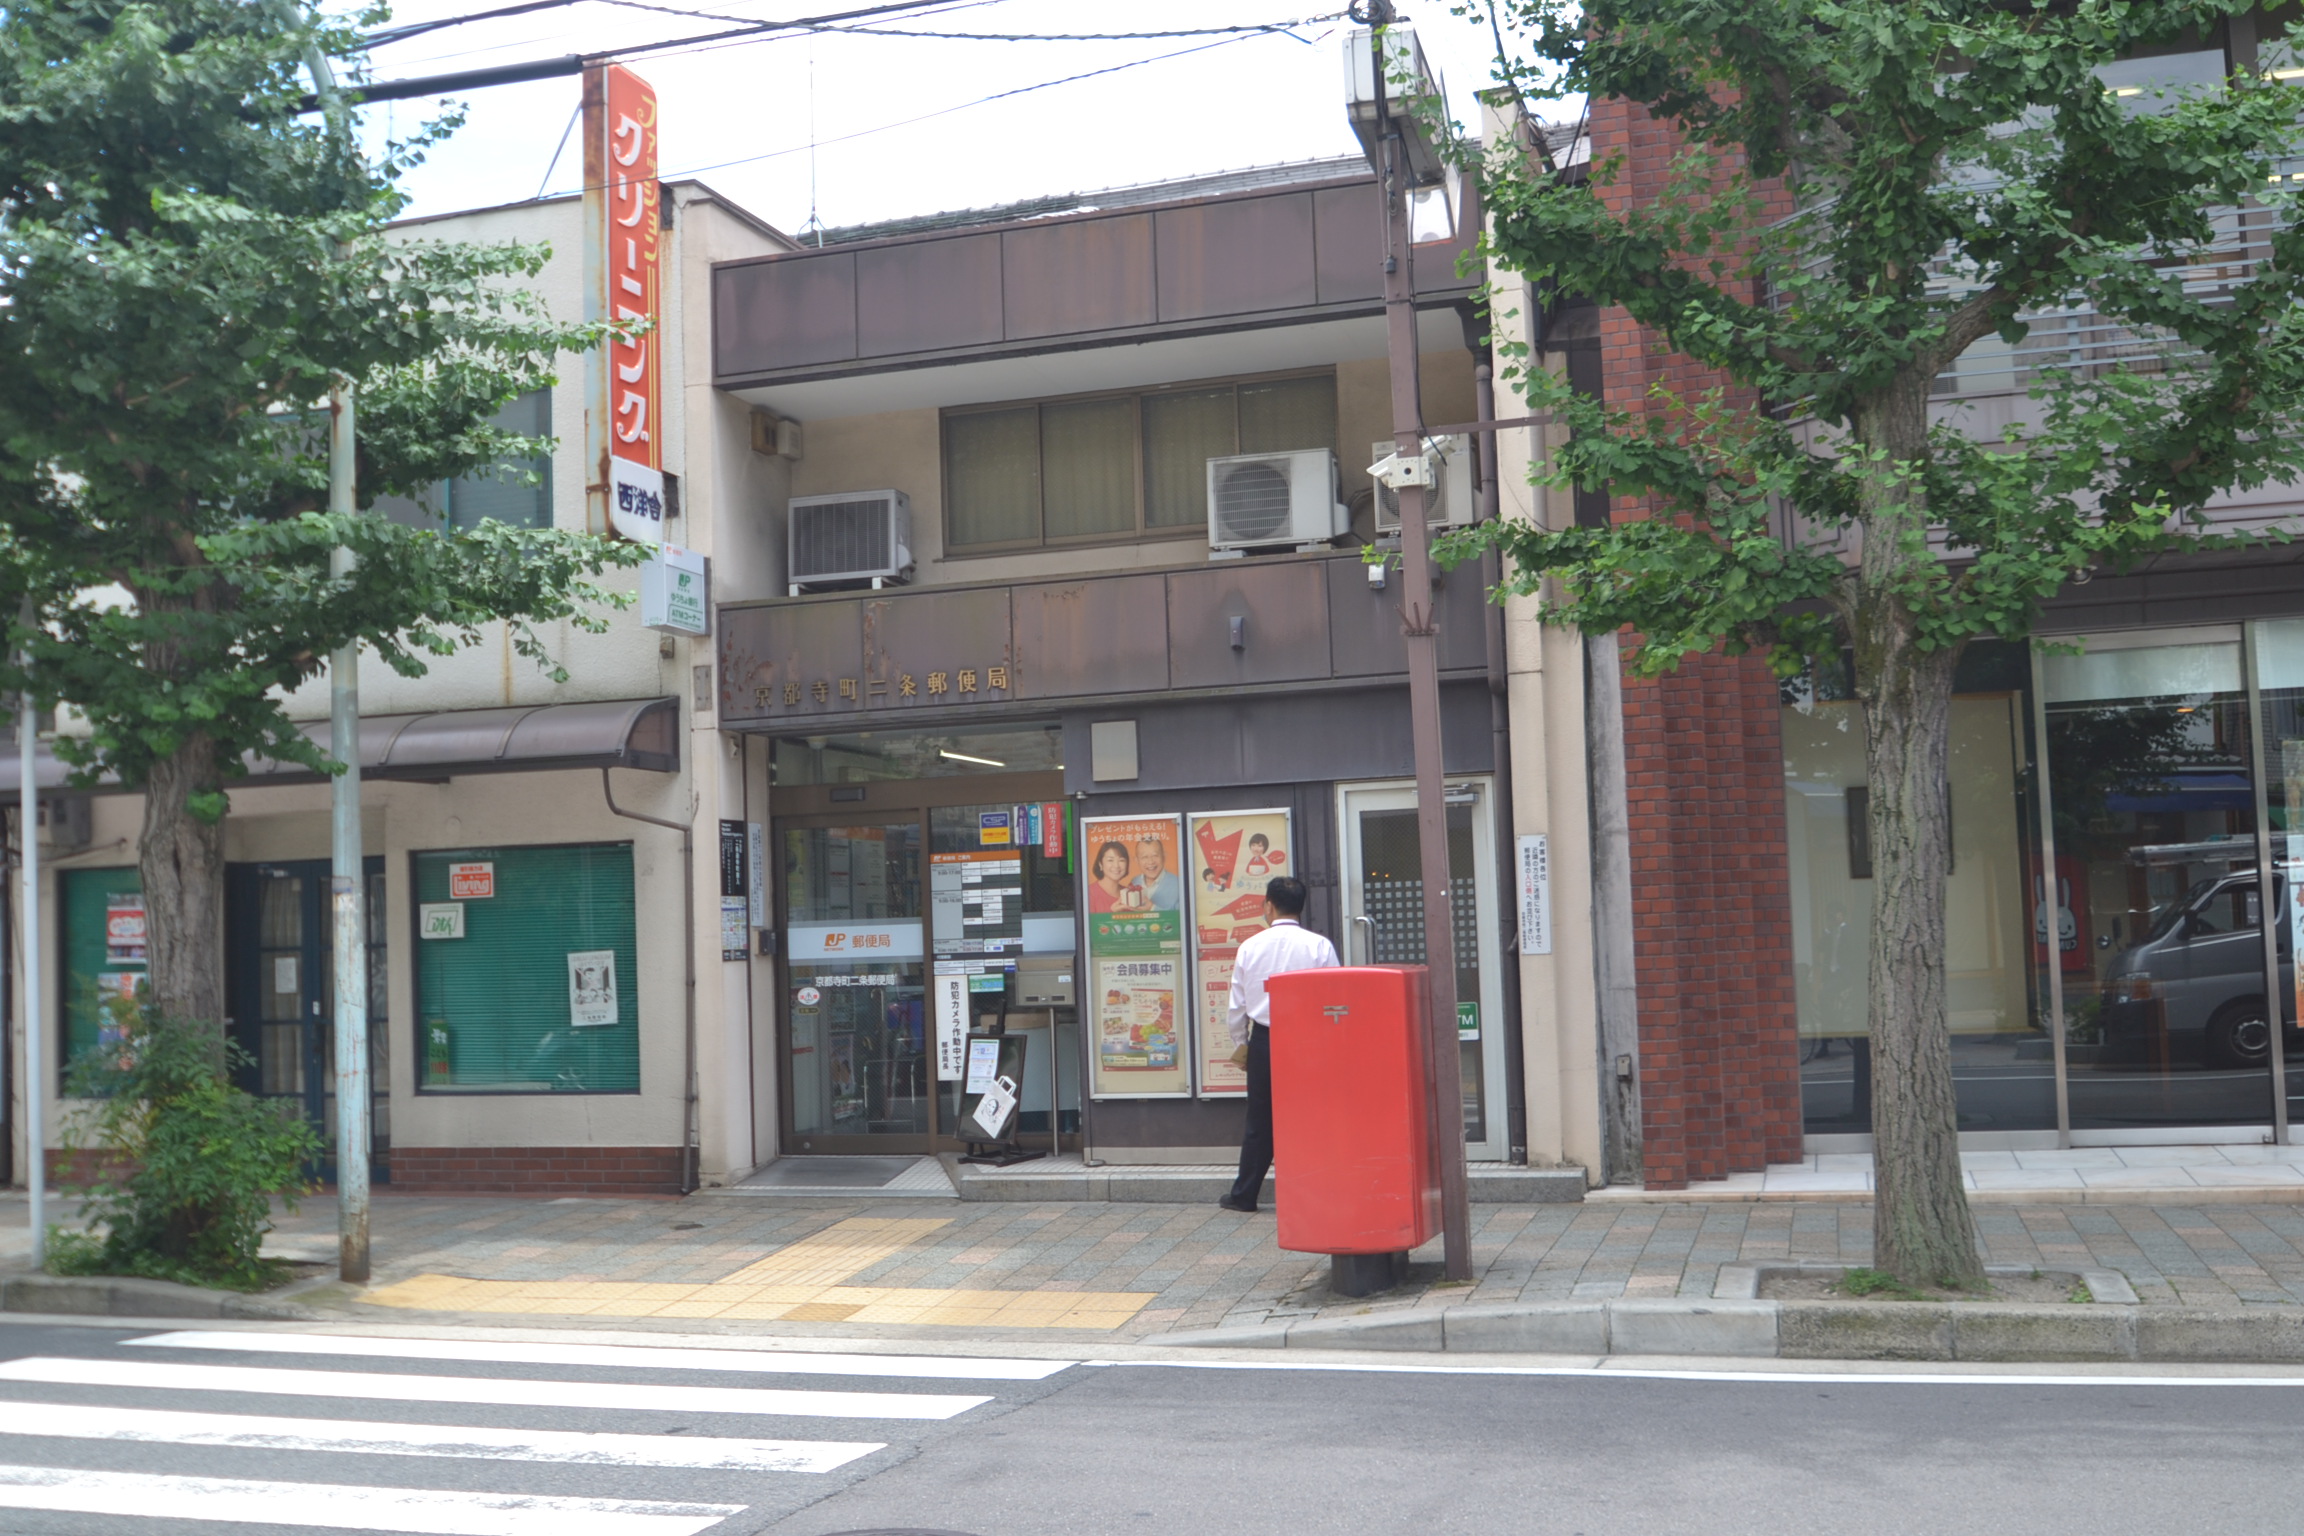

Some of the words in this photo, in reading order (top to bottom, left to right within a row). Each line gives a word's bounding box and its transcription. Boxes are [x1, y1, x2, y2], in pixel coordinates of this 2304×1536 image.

[637, 93, 658, 262] ファッション
[612, 112, 651, 444] クリーニング
[617, 480, 662, 523] 西洋舎
[753, 666, 1008, 708] 京都寺町二条郵便局
[1047, 806, 1059, 855] 防犯カメラ作動中
[824, 933, 847, 947] JP
[851, 934, 891, 949] 郵便局
[814, 974, 898, 988] 京都寺町二条郵便局
[1116, 962, 1173, 977] 会員募集中
[949, 981, 962, 1075] 防犯カメラ作動中です
[941, 1041, 950, 1071] 郵便局長
